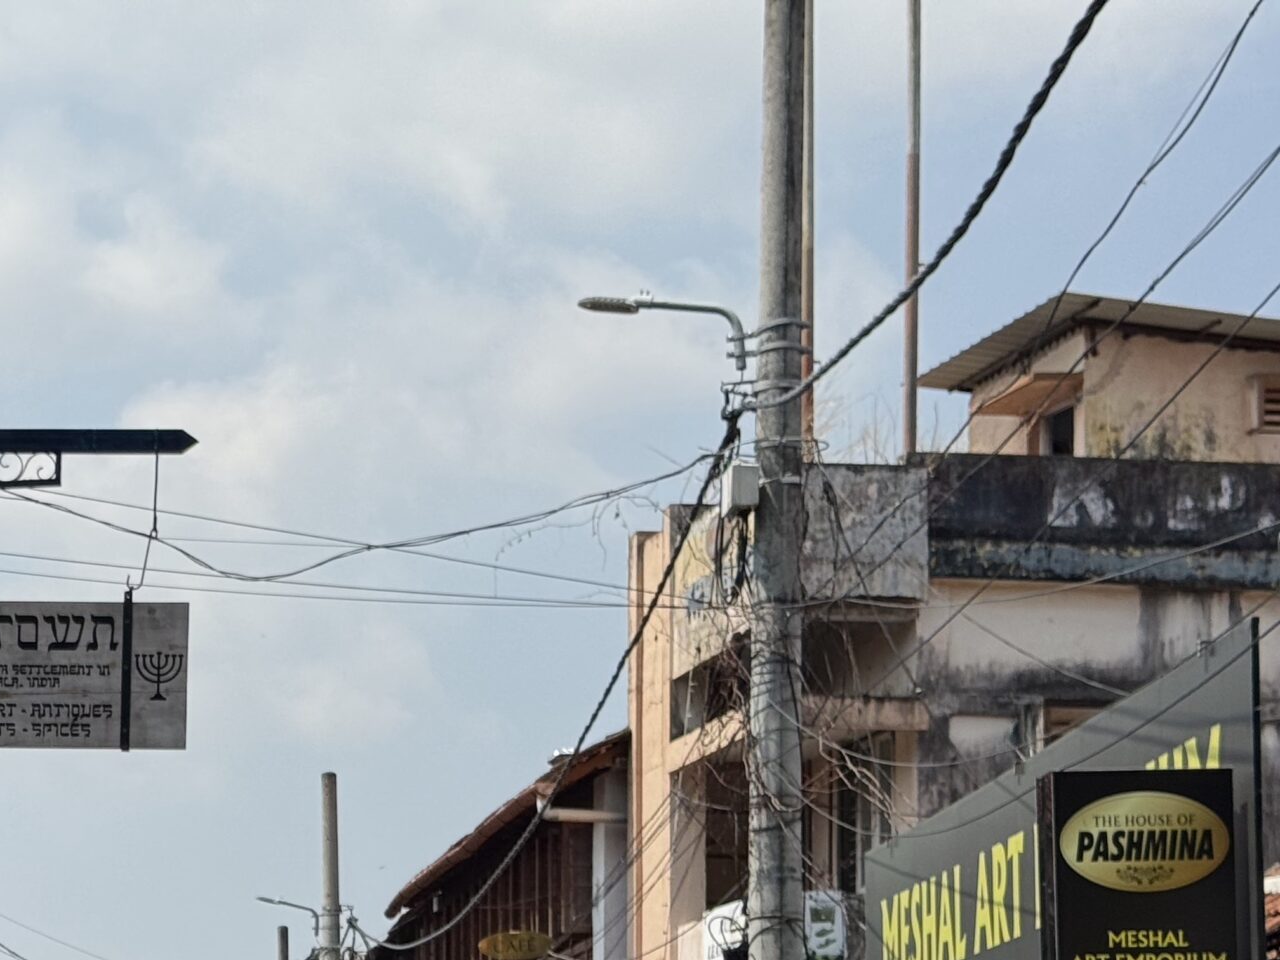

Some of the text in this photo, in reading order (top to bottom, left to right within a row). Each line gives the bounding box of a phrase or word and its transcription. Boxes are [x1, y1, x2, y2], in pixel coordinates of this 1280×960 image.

[12, 664, 94, 676] SETTLEMENT
[96, 664, 111, 676] IN
[26, 677, 60, 688] INDIA
[30, 703, 113, 722] ANTIQUES
[31, 722, 91, 738] SPICES
[1091, 814, 1196, 828] THE HOUSE OF
[1075, 829, 1215, 864] PASHMINA
[973, 831, 1025, 956] ART
[1107, 929, 1189, 949] MESHAL
